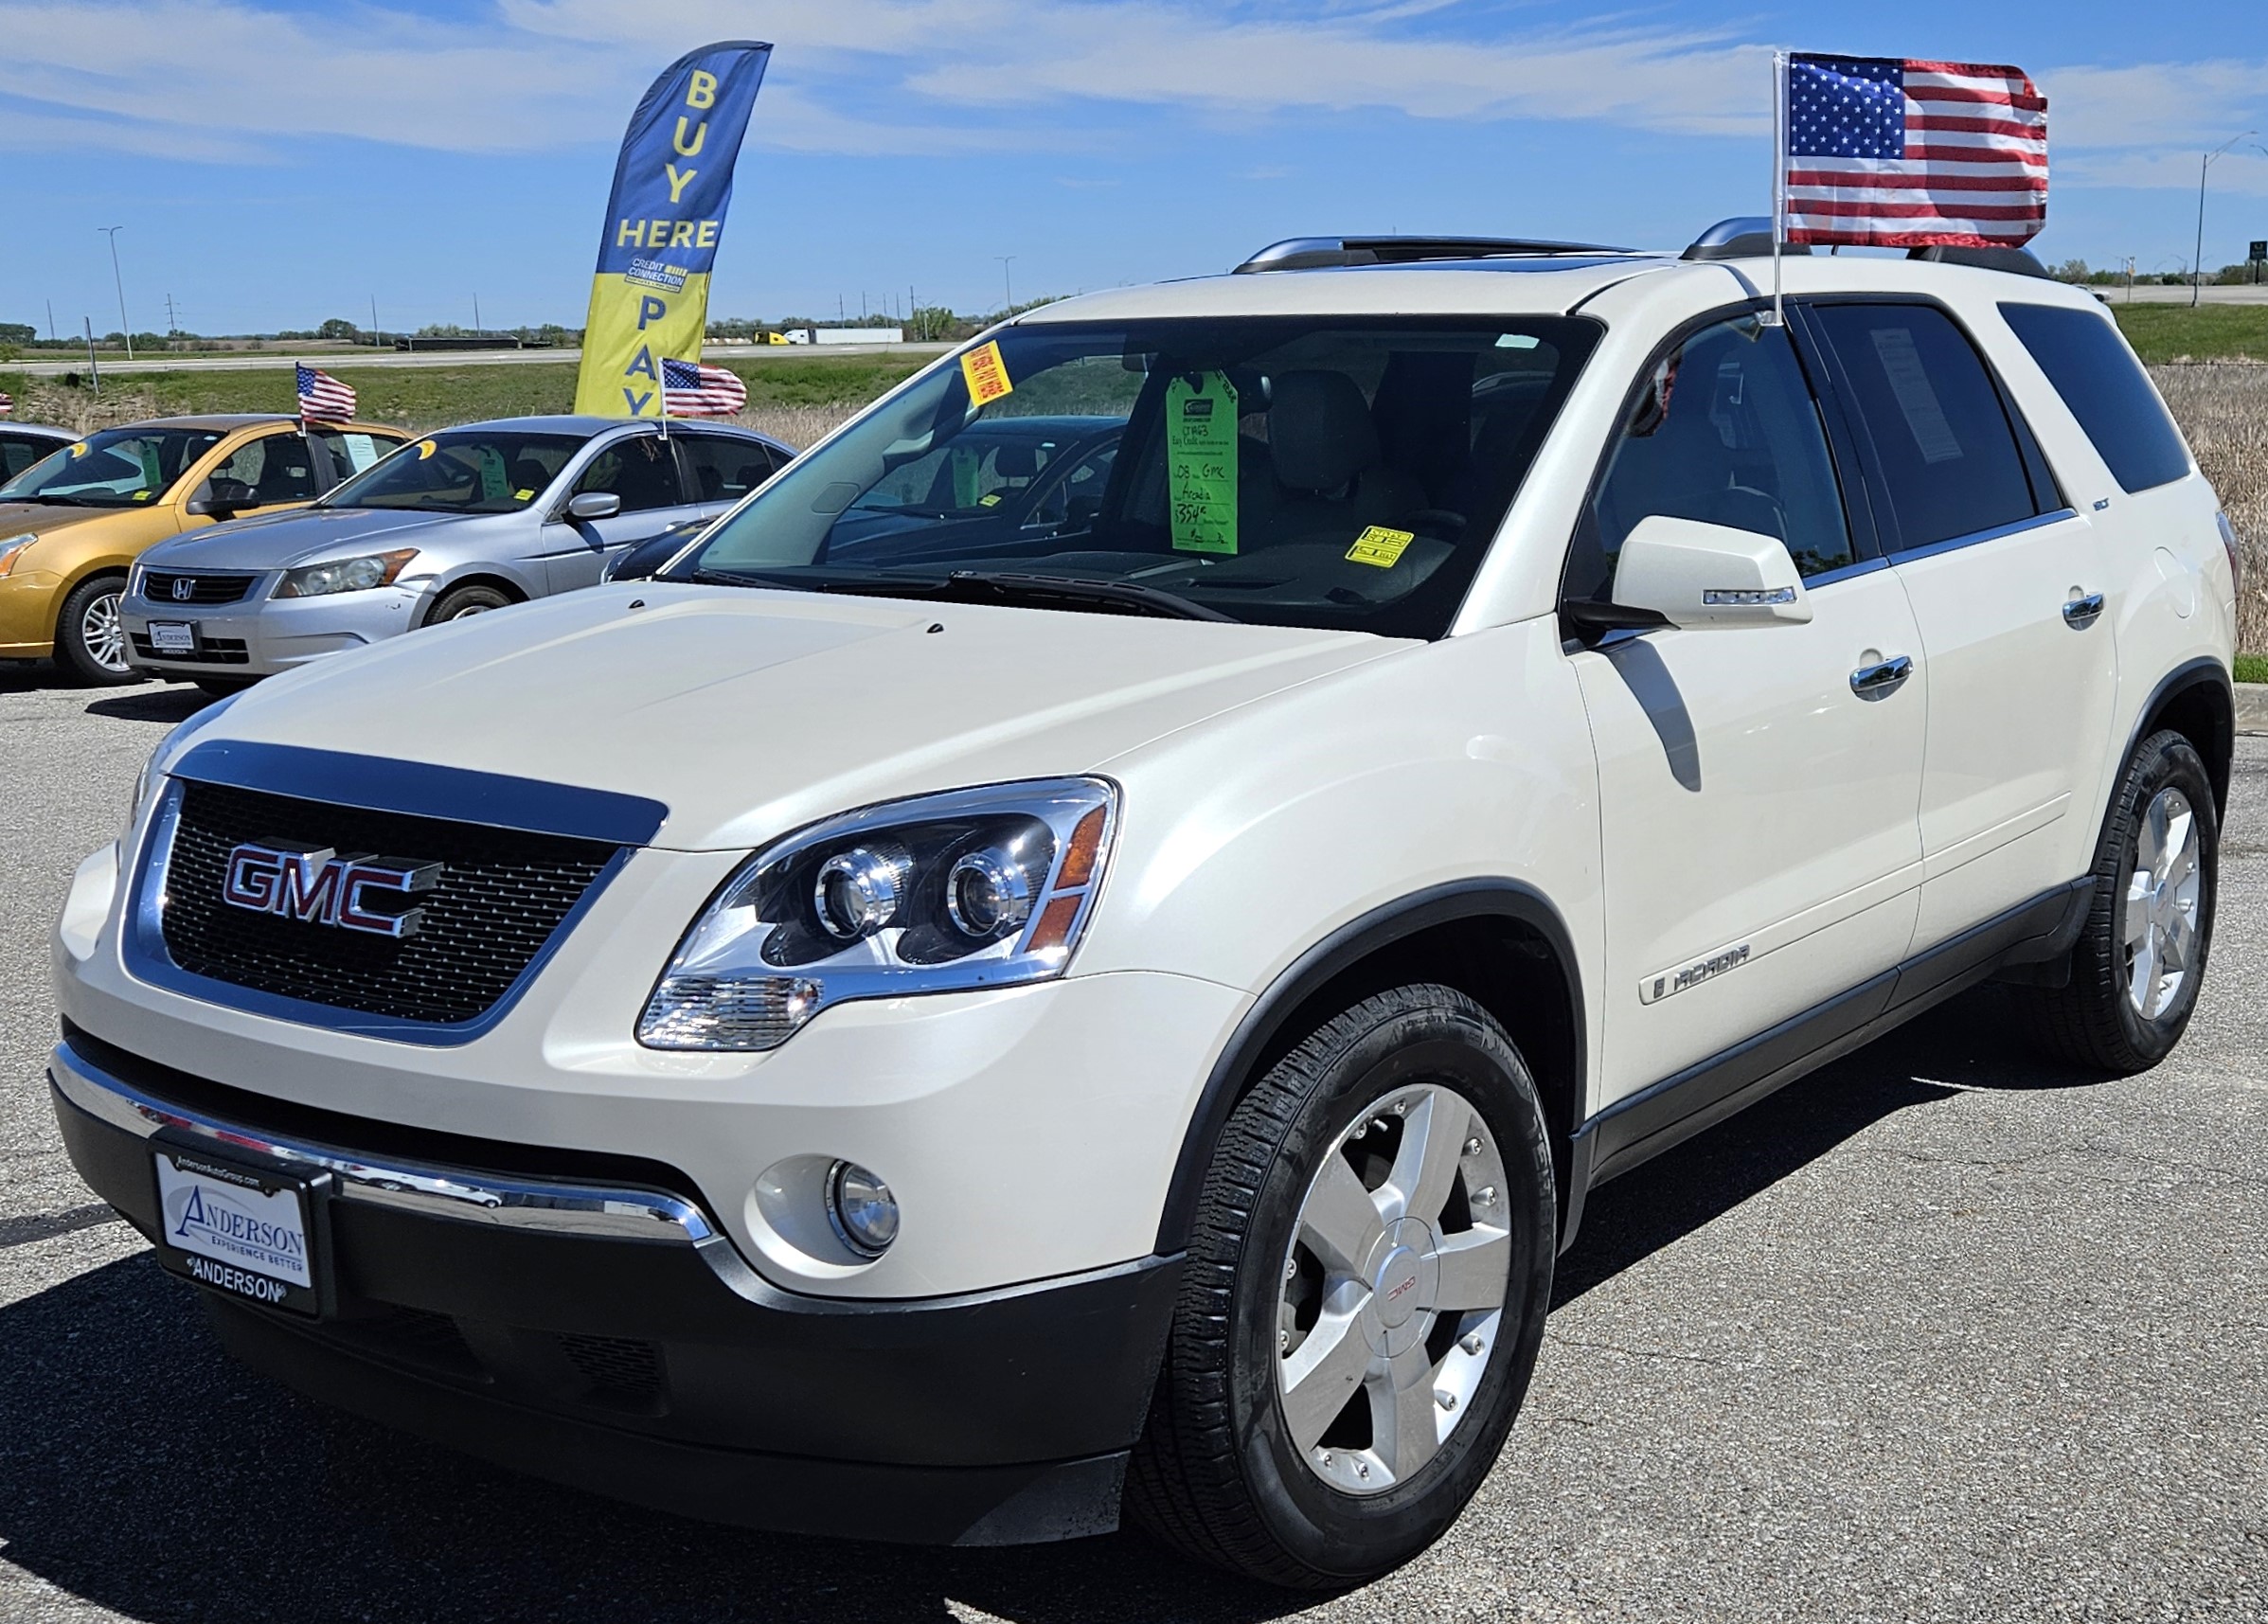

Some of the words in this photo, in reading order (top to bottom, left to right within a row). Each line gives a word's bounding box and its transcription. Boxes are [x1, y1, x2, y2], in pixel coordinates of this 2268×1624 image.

[666, 70, 718, 204] BUY
[616, 219, 719, 248] HERE
[628, 266, 685, 286] CONNECTION
[632, 258, 665, 272] CREDIT
[622, 294, 667, 417] PAY
[223, 843, 426, 938] GMC
[1673, 944, 1750, 991] ACADIA
[175, 1185, 303, 1256] ANDERSON
[211, 1236, 265, 1261] EXPERIENCE
[268, 1249, 303, 1273] BETTER
[192, 1258, 279, 1303] ANDERSON
[1386, 1275, 1416, 1302] GMC
